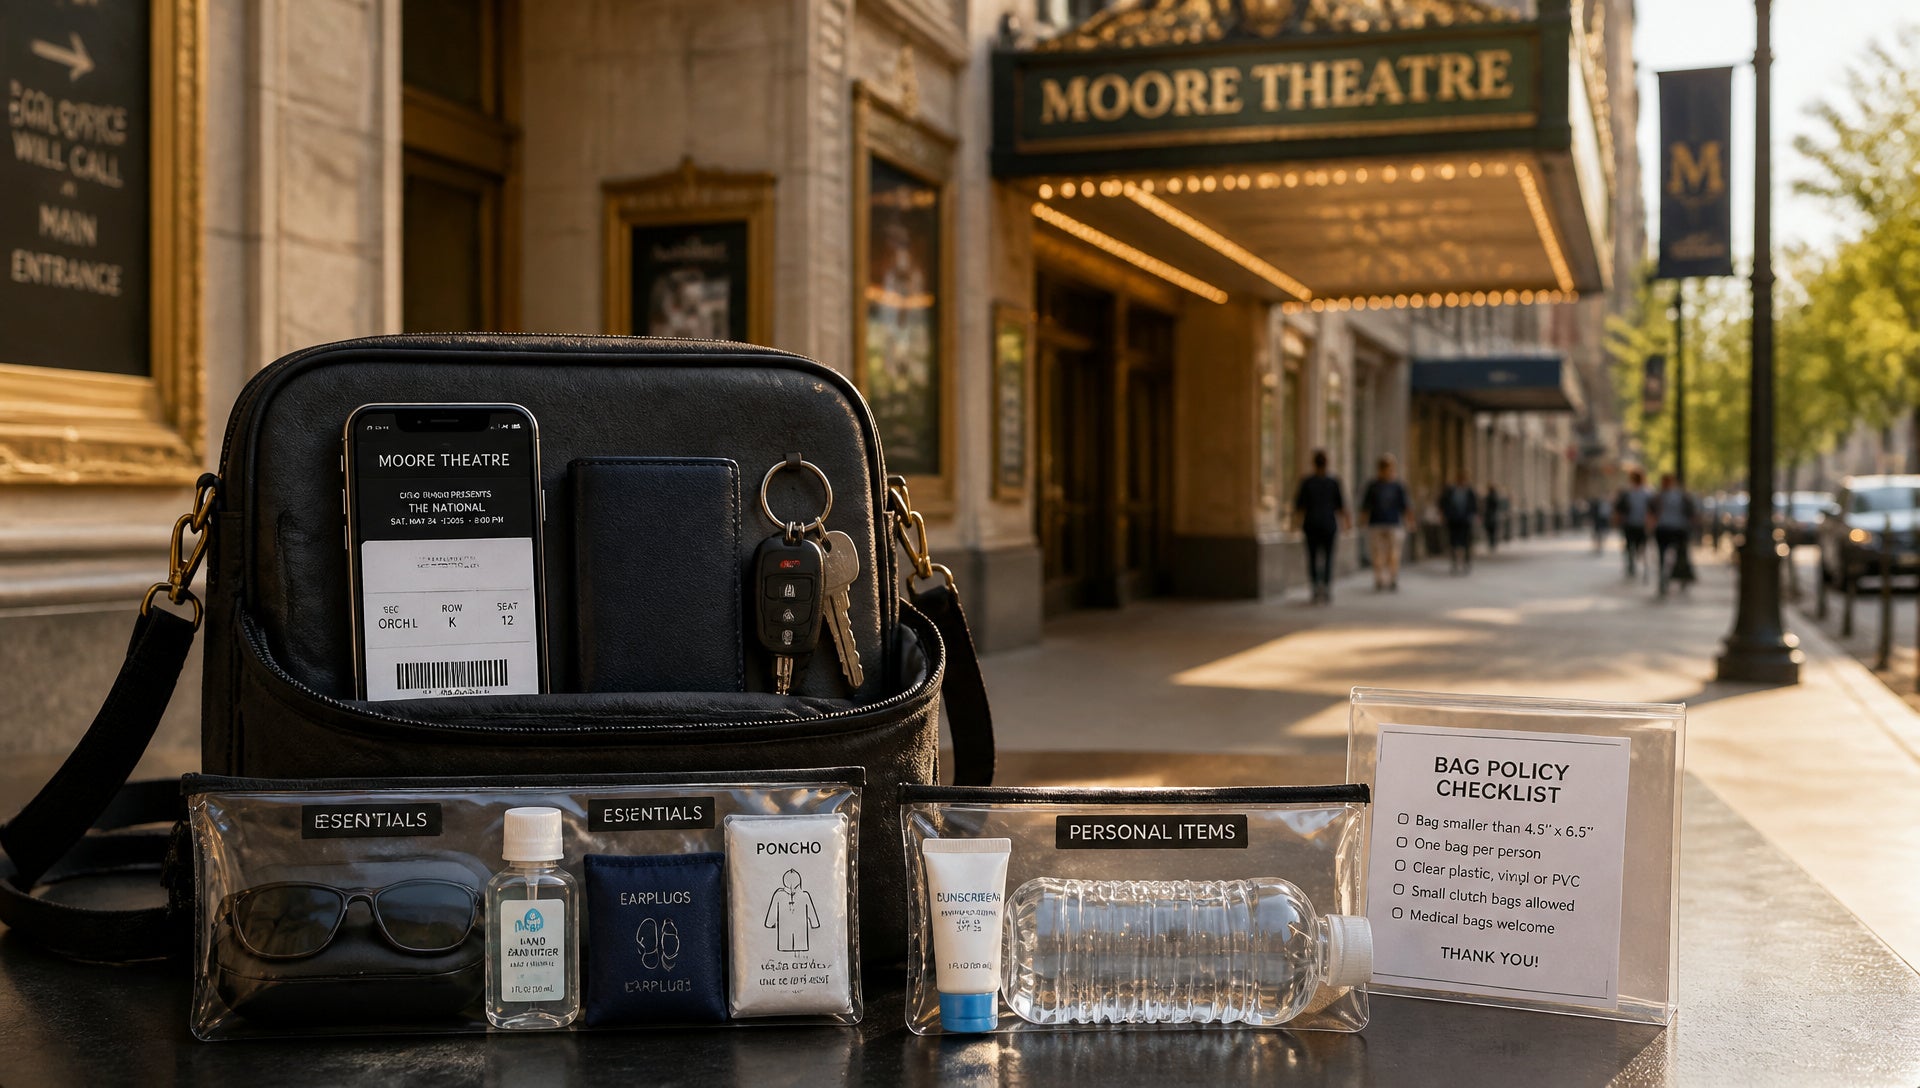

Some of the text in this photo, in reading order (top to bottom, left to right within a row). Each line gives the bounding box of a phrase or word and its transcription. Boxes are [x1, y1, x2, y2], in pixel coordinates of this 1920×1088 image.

[1040, 48, 1514, 125] MOORE THEATRE
[69, 145, 124, 188] CALL
[1669, 140, 1724, 195] M
[39, 203, 98, 247] MAIN
[10, 248, 123, 297] ENTRANCE
[378, 453, 510, 468] MOORE THEATRE
[408, 502, 486, 514] THE NATIONAL
[441, 604, 463, 613] ROW
[496, 602, 518, 612] SEAT
[448, 617, 457, 628] K
[501, 615, 514, 626] 12
[1434, 756, 1570, 781] BAG POLICY
[1436, 779, 1561, 804] CHECKLIST
[603, 805, 703, 823] ESSENTIALS
[1415, 814, 1439, 829] Bag
[1443, 818, 1488, 832] smaller
[1492, 821, 1520, 834] than
[1554, 828, 1562, 836] x
[1069, 823, 1236, 841] PERSONAL ITEMS
[756, 841, 822, 855] PONCHO
[1414, 837, 1541, 860] One bag per person
[1413, 861, 1446, 875] Clear
[1449, 864, 1494, 882] plastic,
[1533, 876, 1548, 885] or
[1552, 873, 1581, 888] PVC
[620, 891, 691, 906] EARPLUGS
[1411, 885, 1575, 912] Small clutch bags allowed
[1410, 909, 1555, 935] Medical bags welcome
[1441, 946, 1539, 968] THANK YOU!
